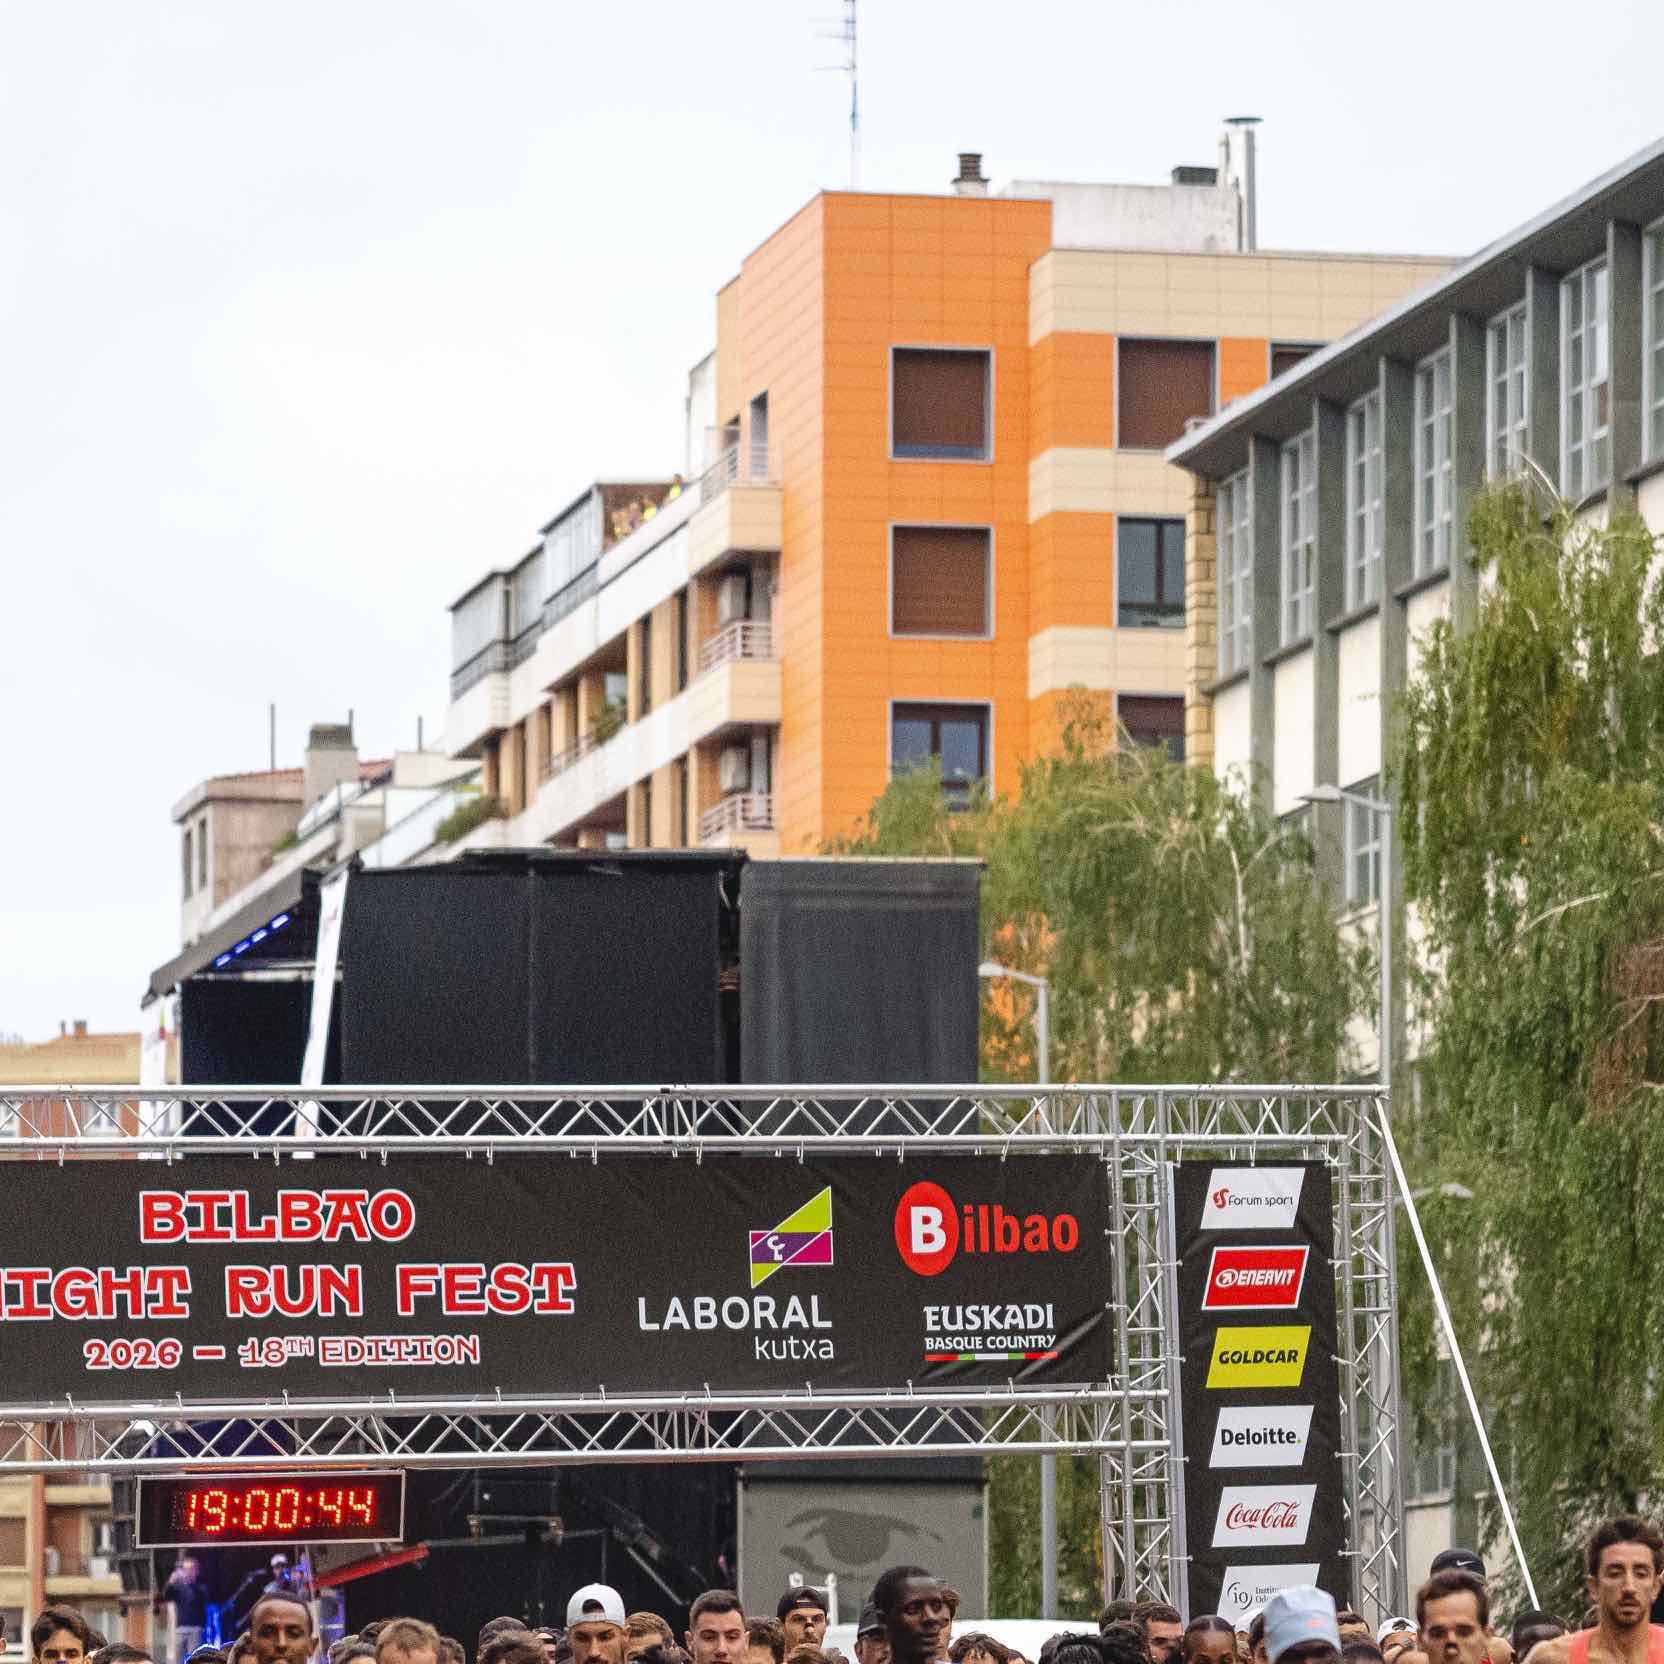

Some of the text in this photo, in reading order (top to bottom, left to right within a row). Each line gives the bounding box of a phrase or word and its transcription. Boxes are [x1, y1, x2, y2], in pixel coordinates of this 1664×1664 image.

[1265, 1195, 1294, 1207] sport
[139, 1189, 416, 1243] BILBAO
[910, 1205, 1079, 1253] Bilbao
[225, 1264, 363, 1318] RUN
[395, 1262, 577, 1315] FEST
[1237, 1269, 1296, 1286] ENERVIT
[638, 1295, 833, 1331] LABORAL
[923, 1304, 1054, 1331] EUSKADI
[83, 1337, 182, 1368] 2026
[238, 1336, 315, 1368] 18TH
[318, 1335, 480, 1365] EDITION
[754, 1335, 834, 1359] kutxa
[925, 1335, 1056, 1351] BASQUE COUNTRY
[1218, 1350, 1299, 1365] GOLDCAR
[187, 1488, 375, 1532] 19:00:44
[1226, 1501, 1301, 1529] Coca-Cola
